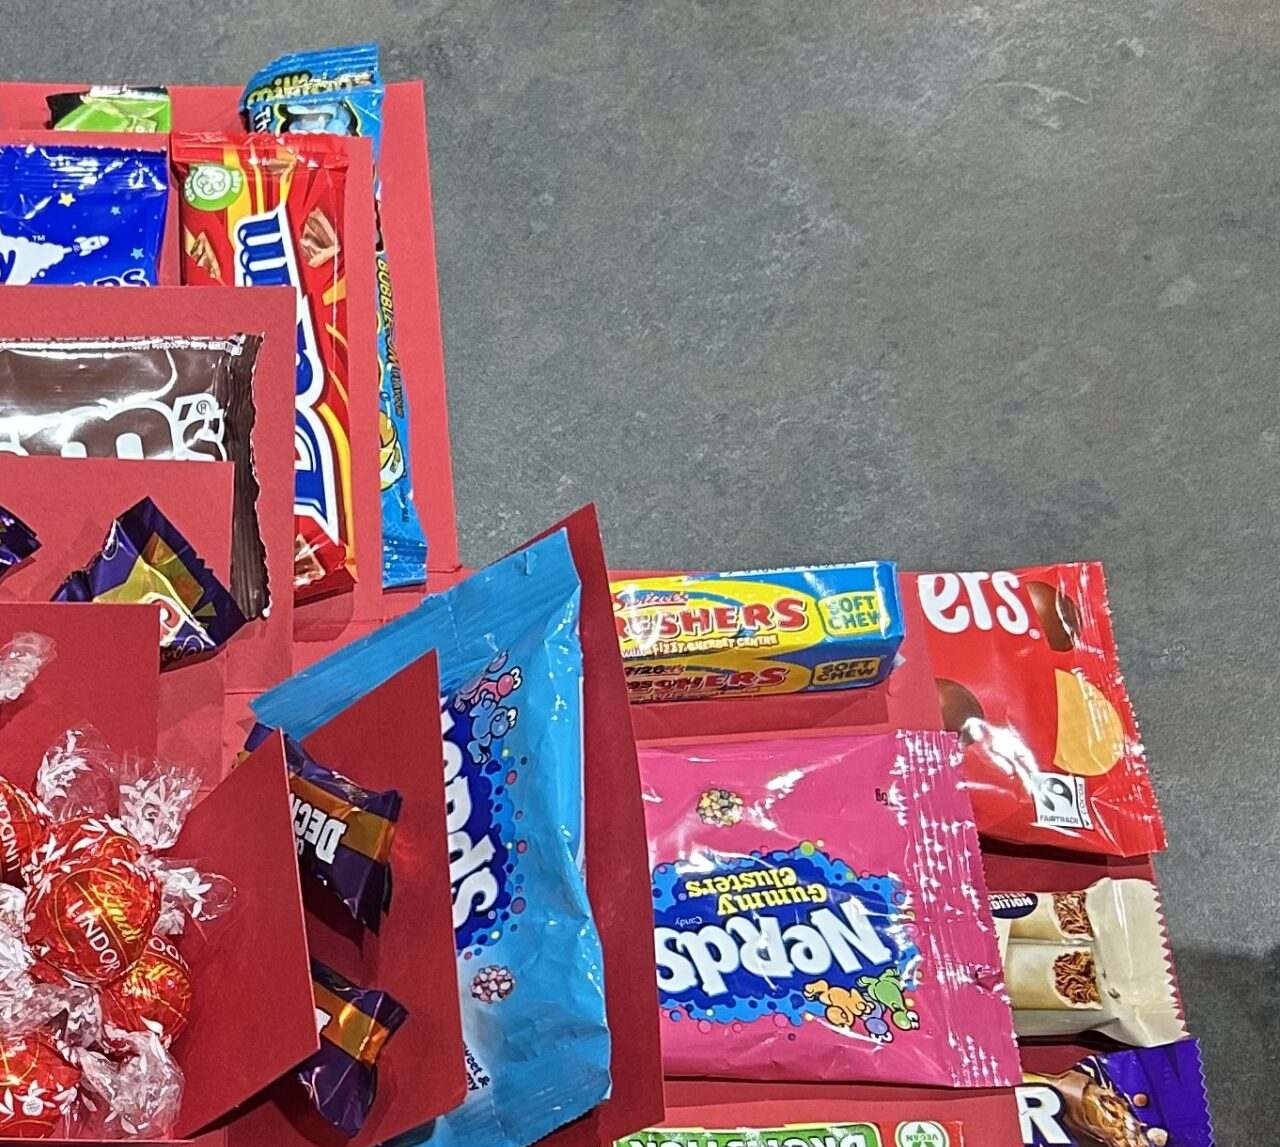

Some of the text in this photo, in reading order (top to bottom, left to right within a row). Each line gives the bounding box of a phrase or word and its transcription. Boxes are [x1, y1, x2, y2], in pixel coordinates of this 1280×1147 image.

[822, 659, 874, 674] SOFT
[816, 668, 876, 683] CHEW
[717, 882, 827, 917] Gummy
[990, 897, 1035, 911] DITION
[674, 914, 702, 928] Candy
[66, 900, 121, 973] LINDOR
[904, 1132, 940, 1143] VEGAN
